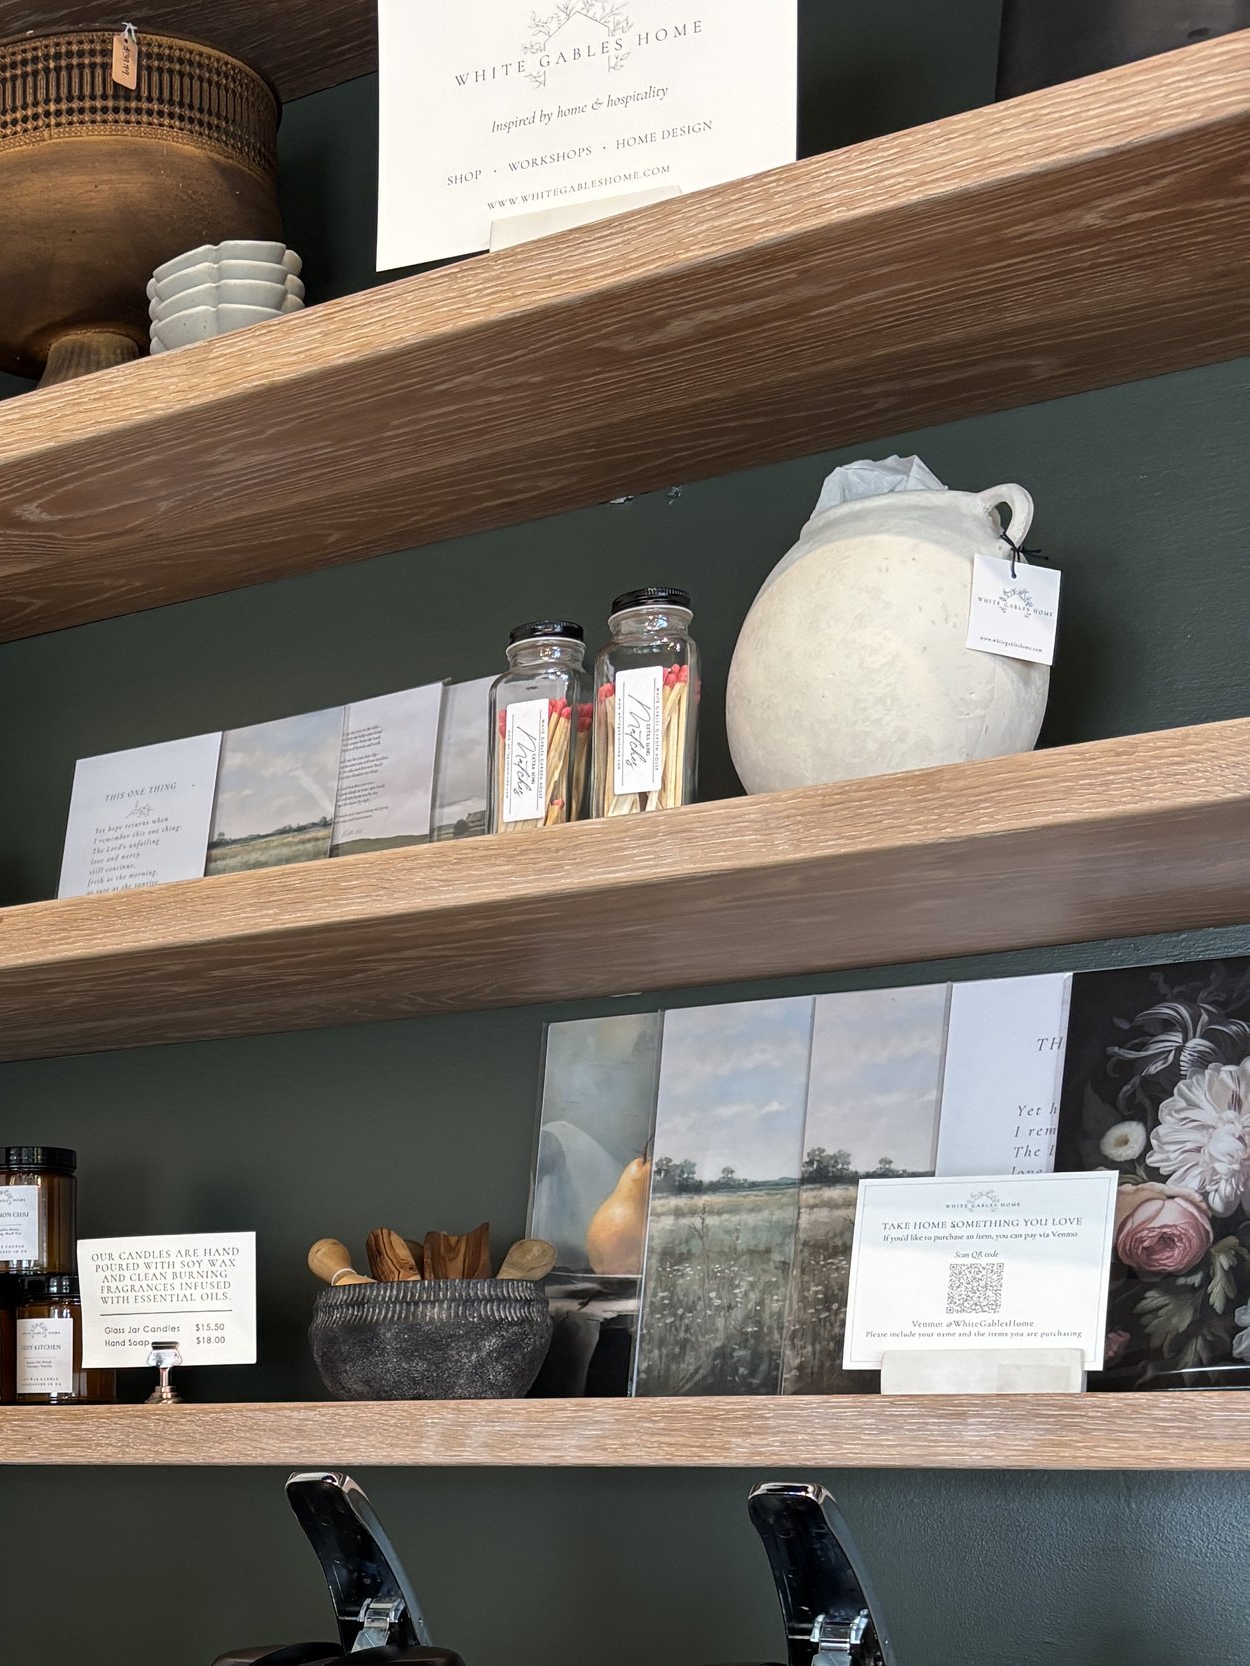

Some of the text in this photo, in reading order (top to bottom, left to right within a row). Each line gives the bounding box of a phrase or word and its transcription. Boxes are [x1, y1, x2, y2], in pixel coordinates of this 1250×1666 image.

[454, 20, 703, 87] WHITE GABLES HOME
[491, 85, 669, 134] Inspired by home & hospitality
[446, 120, 714, 187] SHOP WORKSHOPS HOME DESIGN
[487, 164, 672, 212] WWW.WHITEGABLESHOME.COM
[978, 596, 1054, 618] WHITE GABLES HOME
[625, 694, 652, 770] Matches
[513, 726, 537, 798] Matches
[105, 782, 178, 802] THIS ONE THING
[1018, 1104, 1042, 1117] Yet
[1013, 1145, 1042, 1158] The
[881, 1217, 1083, 1230] TAKE HOME SOMETHING YOU LOVE
[910, 1233, 924, 1241] like
[933, 1233, 965, 1243] purchase
[995, 1233, 1009, 1242] you
[1024, 1233, 1037, 1241] pay
[1038, 1231, 1050, 1239] via
[1051, 1230, 1078, 1238] Venmo
[91, 1246, 240, 1263] OUR CANDLES ARE HAND
[954, 1250, 999, 1260] Scan QR code
[95, 1258, 236, 1273] POURED WITH SOY WAX
[102, 1269, 228, 1284] AND CLEAN BURNING
[100, 1280, 231, 1294] FRAGRANCES INFUSED
[100, 1291, 232, 1305] WITH ESSENTIAL OILS.
[104, 1322, 225, 1335] Glass Jar Candles $15.50
[912, 1319, 1035, 1328] Venmo: @WhiteGablesHome
[889, 1330, 916, 1338] include
[918, 1331, 934, 1339] your
[957, 1330, 972, 1338] and
[974, 1330, 986, 1338] the
[988, 1330, 1008, 1338] items
[1040, 1330, 1083, 1339] purchasing
[104, 1336, 226, 1349] Hand Soap $18.00
